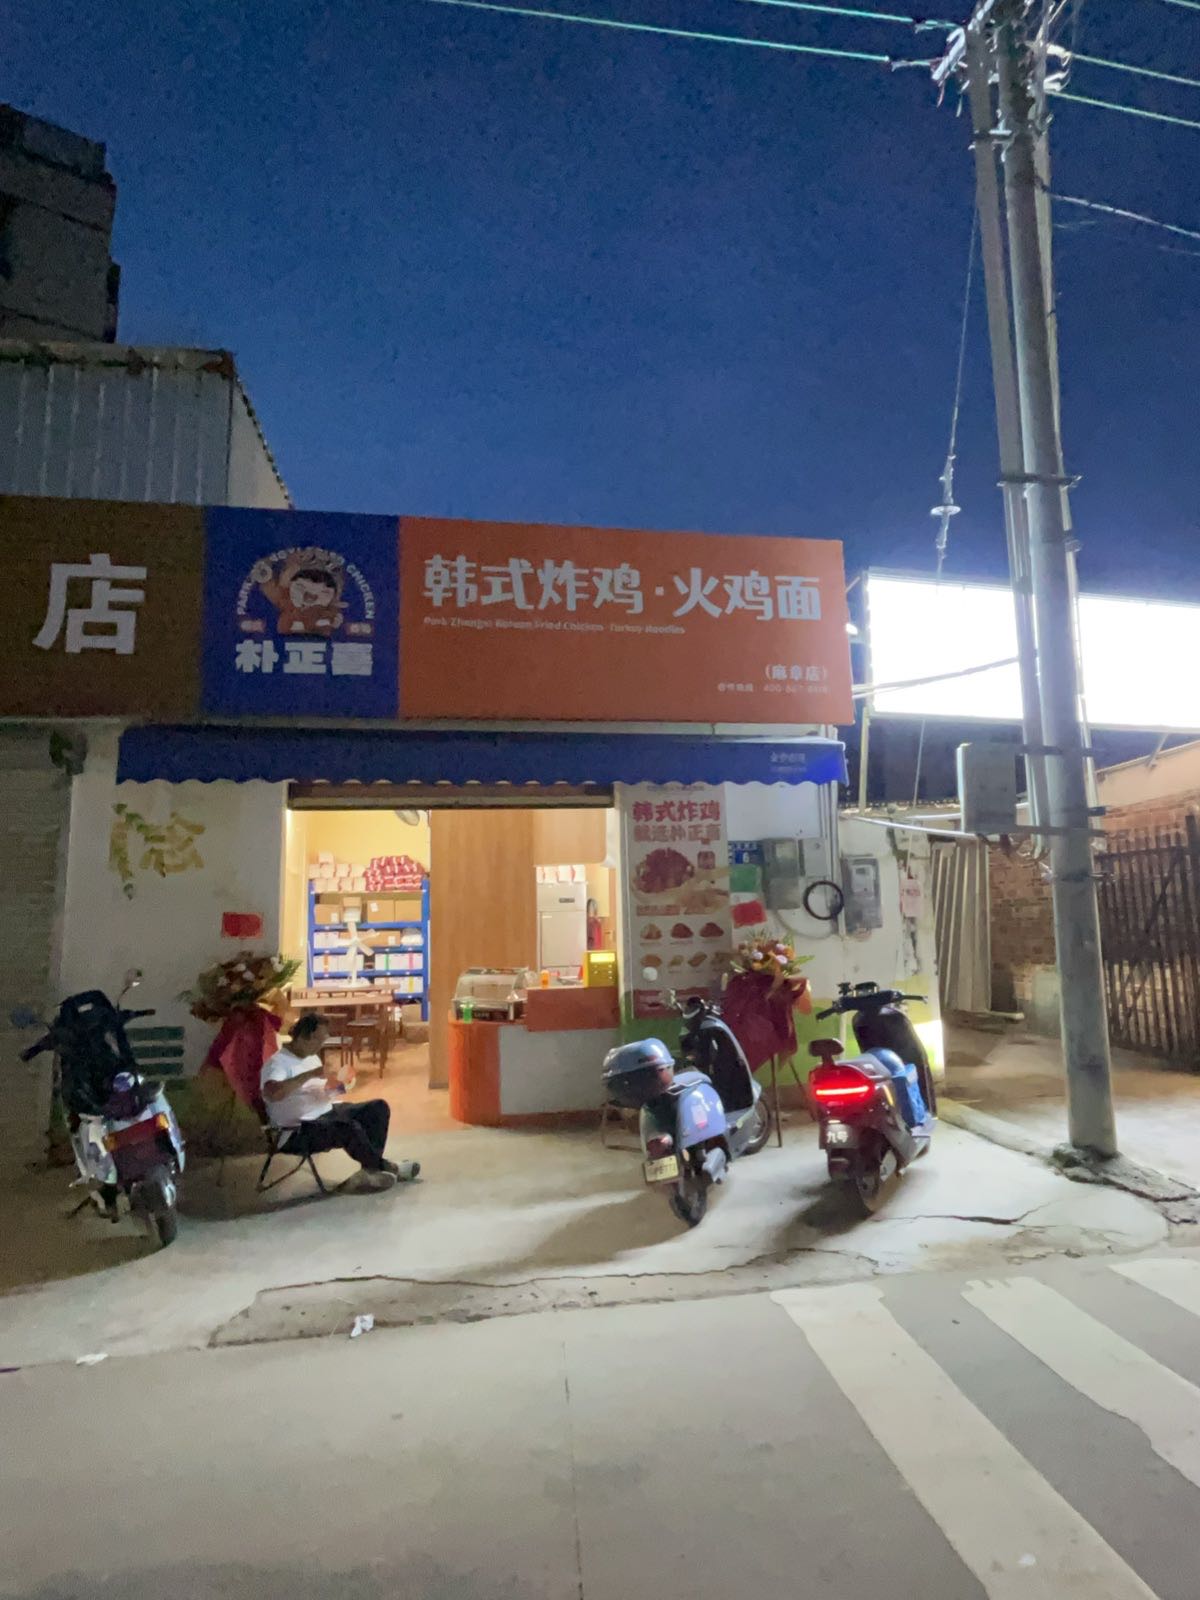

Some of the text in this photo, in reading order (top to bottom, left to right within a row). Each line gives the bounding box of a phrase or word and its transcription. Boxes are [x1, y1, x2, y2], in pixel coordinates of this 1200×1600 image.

[32, 553, 147, 655] 店
[347, 563, 376, 620] CHICKEN
[826, 1131, 849, 1144] 九号
